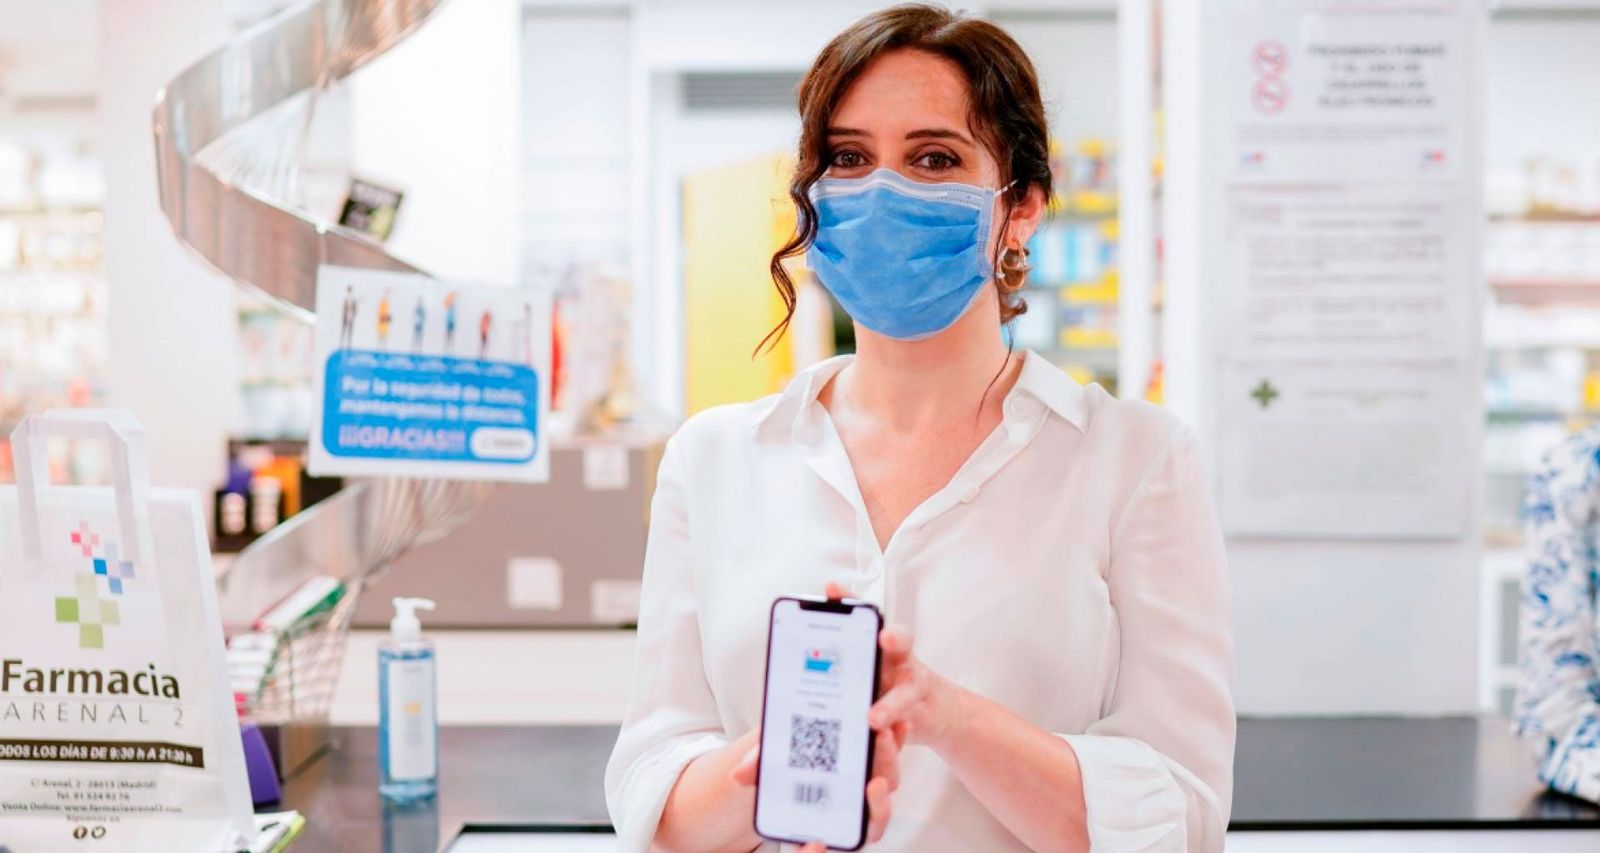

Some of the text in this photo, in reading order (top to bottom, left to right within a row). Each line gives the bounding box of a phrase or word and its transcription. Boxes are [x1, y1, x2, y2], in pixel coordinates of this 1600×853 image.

[1, 658, 180, 699] Farmacia
[3, 701, 185, 728] ARENAL 2
[0, 744, 31, 759] ODOS
[33, 744, 58, 760] LOS
[59, 742, 89, 760] DÍAS
[90, 745, 108, 761] DE
[110, 746, 135, 761] 9:30
[136, 746, 146, 761] h
[146, 747, 157, 761] A
